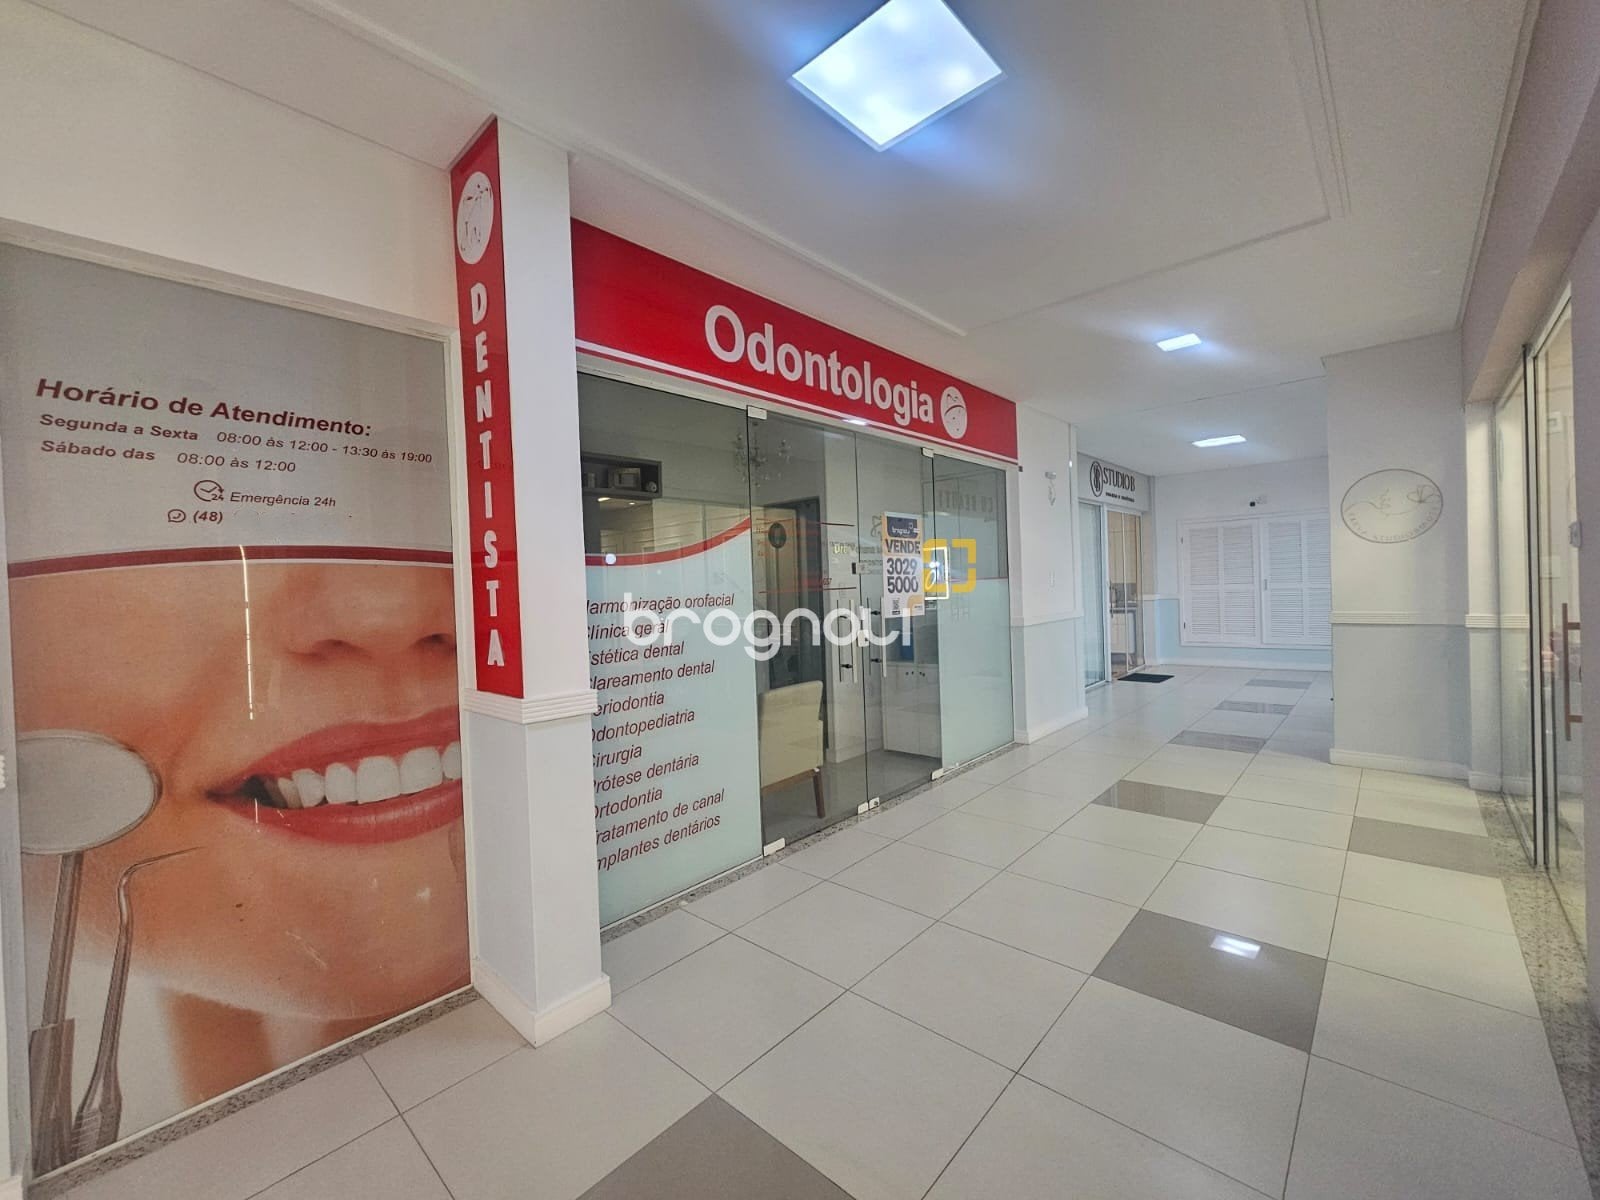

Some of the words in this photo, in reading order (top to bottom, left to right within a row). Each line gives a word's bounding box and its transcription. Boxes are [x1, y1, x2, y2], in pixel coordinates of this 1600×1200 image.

[704, 304, 934, 426] Odontologia
[36, 378, 159, 411] Horário
[168, 397, 203, 416] de
[210, 402, 372, 436] Atendimento:
[39, 414, 128, 433] Segunda
[133, 426, 144, 435] a
[150, 425, 199, 441] Sexta
[216, 431, 262, 446] 08:00
[290, 440, 329, 453] 12:00
[342, 445, 378, 458] 13:30
[400, 452, 433, 464] 19:00
[40, 440, 117, 457] Sábado
[122, 448, 156, 461] das
[177, 452, 225, 467] 08:00
[255, 459, 296, 472] 12:00
[468, 282, 504, 667] DENTISTA
[229, 492, 310, 507] Emergência
[313, 496, 337, 507] 24h
[193, 511, 224, 525] (48)
[886, 539, 921, 554] VENDE
[886, 558, 918, 575] 3029
[887, 576, 919, 594] 5000
[684, 593, 735, 608] orofacial
[589, 647, 639, 666] stética
[643, 641, 685, 660] dental
[589, 666, 673, 691] lareamento
[677, 660, 715, 677] dental
[592, 691, 665, 716] eriodontia
[591, 744, 642, 768] irurgia
[592, 770, 642, 793] rótese
[646, 753, 700, 779] dentária
[595, 810, 669, 845] ratamento
[672, 802, 689, 818] de
[692, 788, 725, 811] canal
[663, 815, 721, 845] dentários
